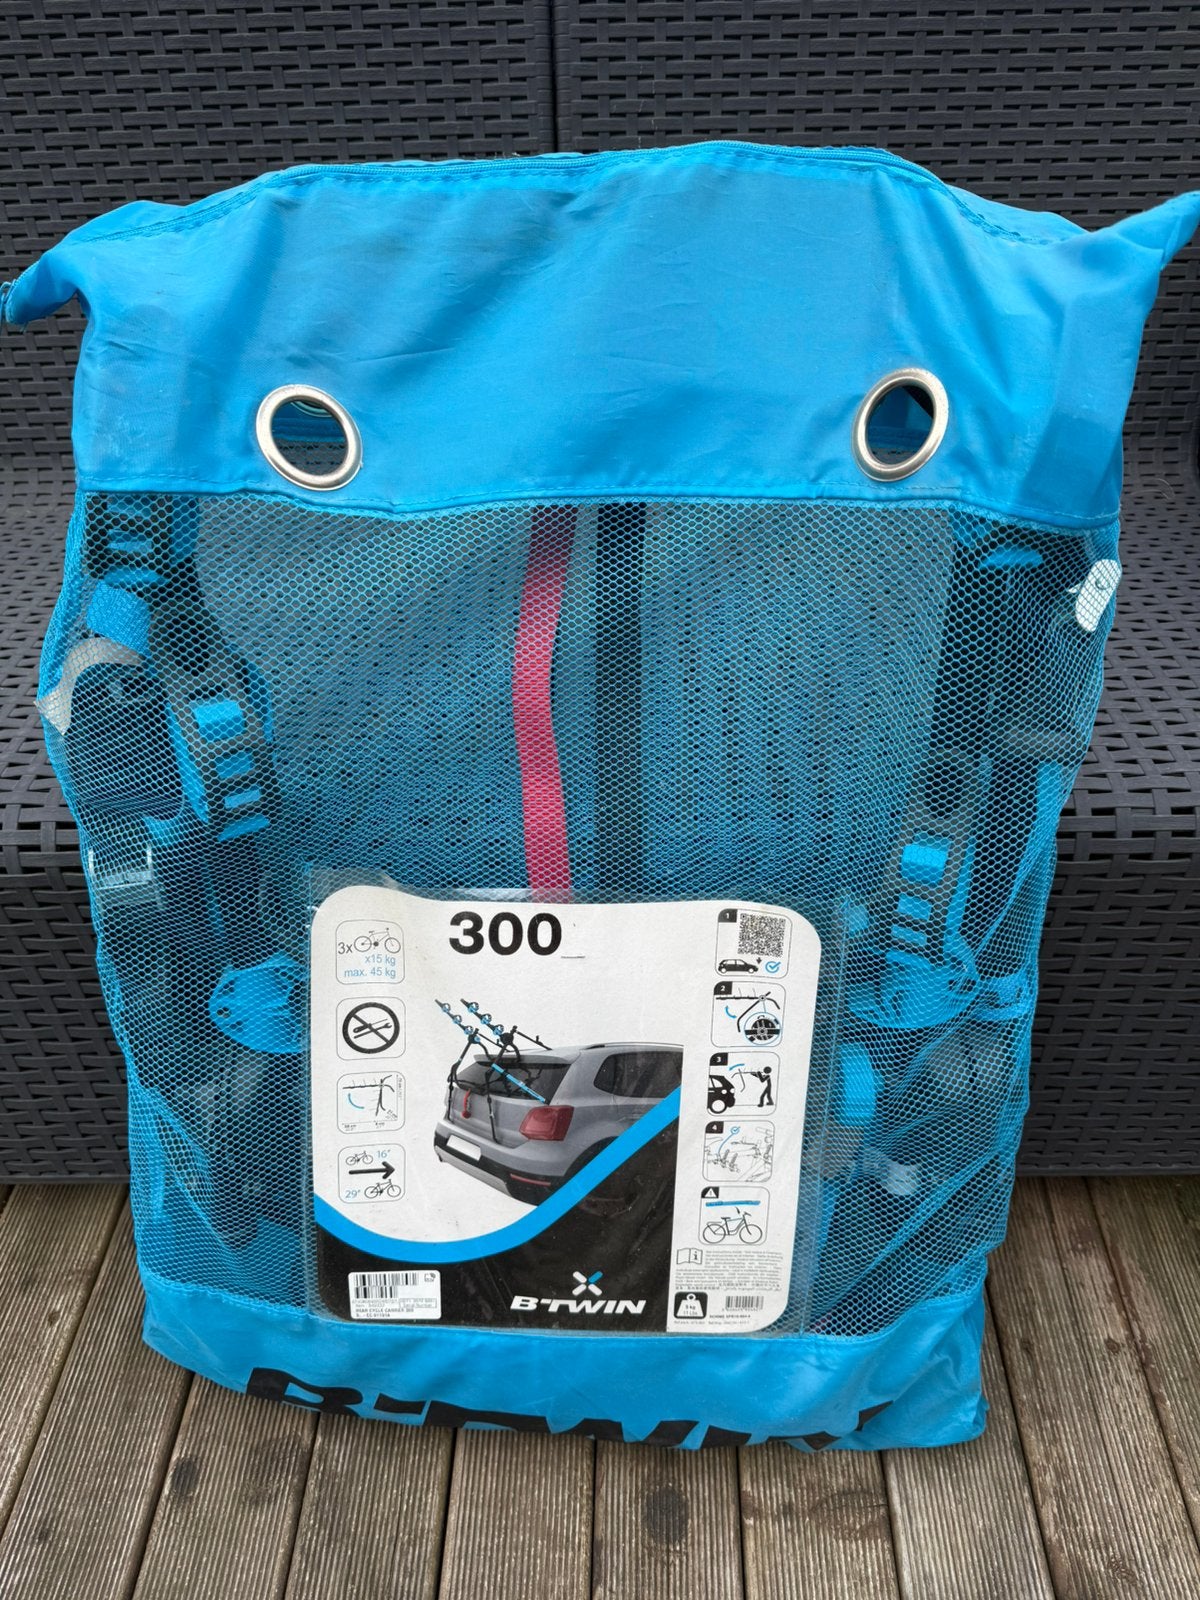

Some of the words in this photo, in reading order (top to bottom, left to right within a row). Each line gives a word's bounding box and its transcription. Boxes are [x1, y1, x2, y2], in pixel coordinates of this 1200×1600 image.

[449, 911, 562, 956] 300
[338, 942, 353, 955] 3x
[365, 954, 383, 964] x15
[385, 954, 396, 967] kg
[344, 968, 367, 977] max.
[370, 967, 382, 976] 45
[385, 967, 396, 979] kg
